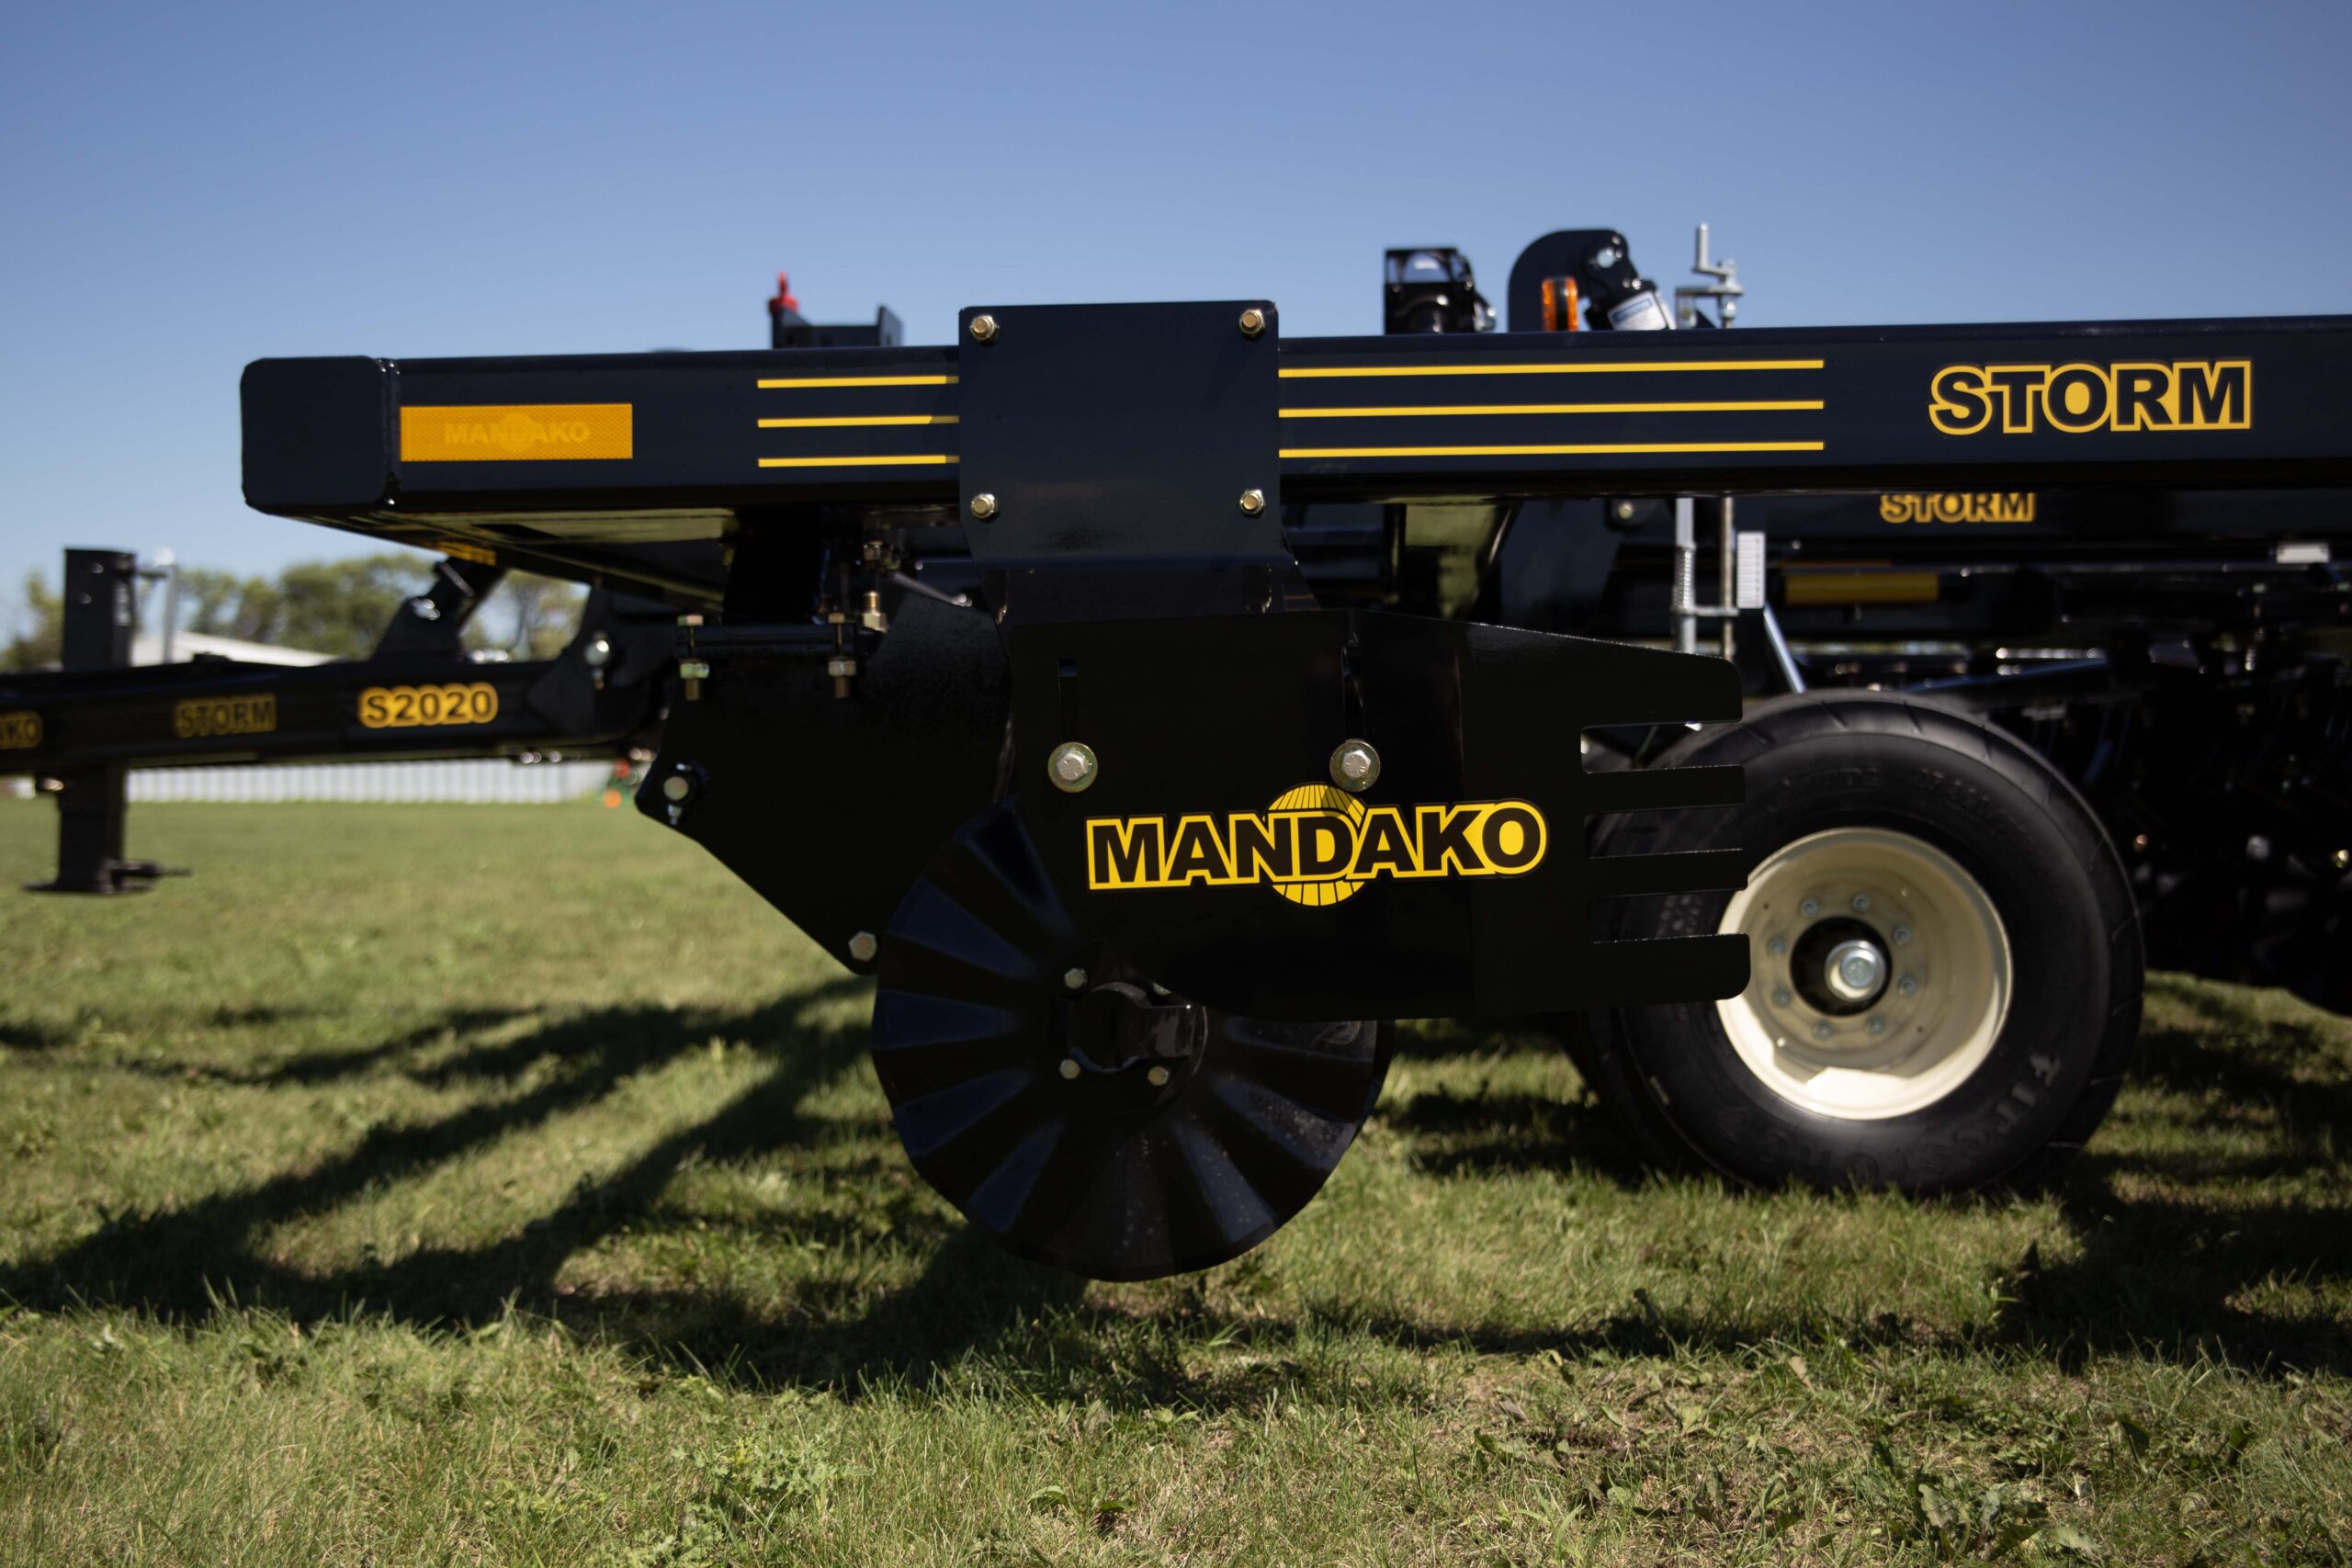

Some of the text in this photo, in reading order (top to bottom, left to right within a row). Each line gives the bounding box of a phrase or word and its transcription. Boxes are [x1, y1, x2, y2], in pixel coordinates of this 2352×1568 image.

[1929, 360, 2251, 435] STORM
[444, 422, 591, 445] MANDAKO
[1880, 492, 2036, 524] STORM
[175, 694, 276, 739] STORM
[357, 681, 499, 728] S2020
[0, 710, 43, 749] KO
[1086, 800, 1547, 890] MANDAKO
